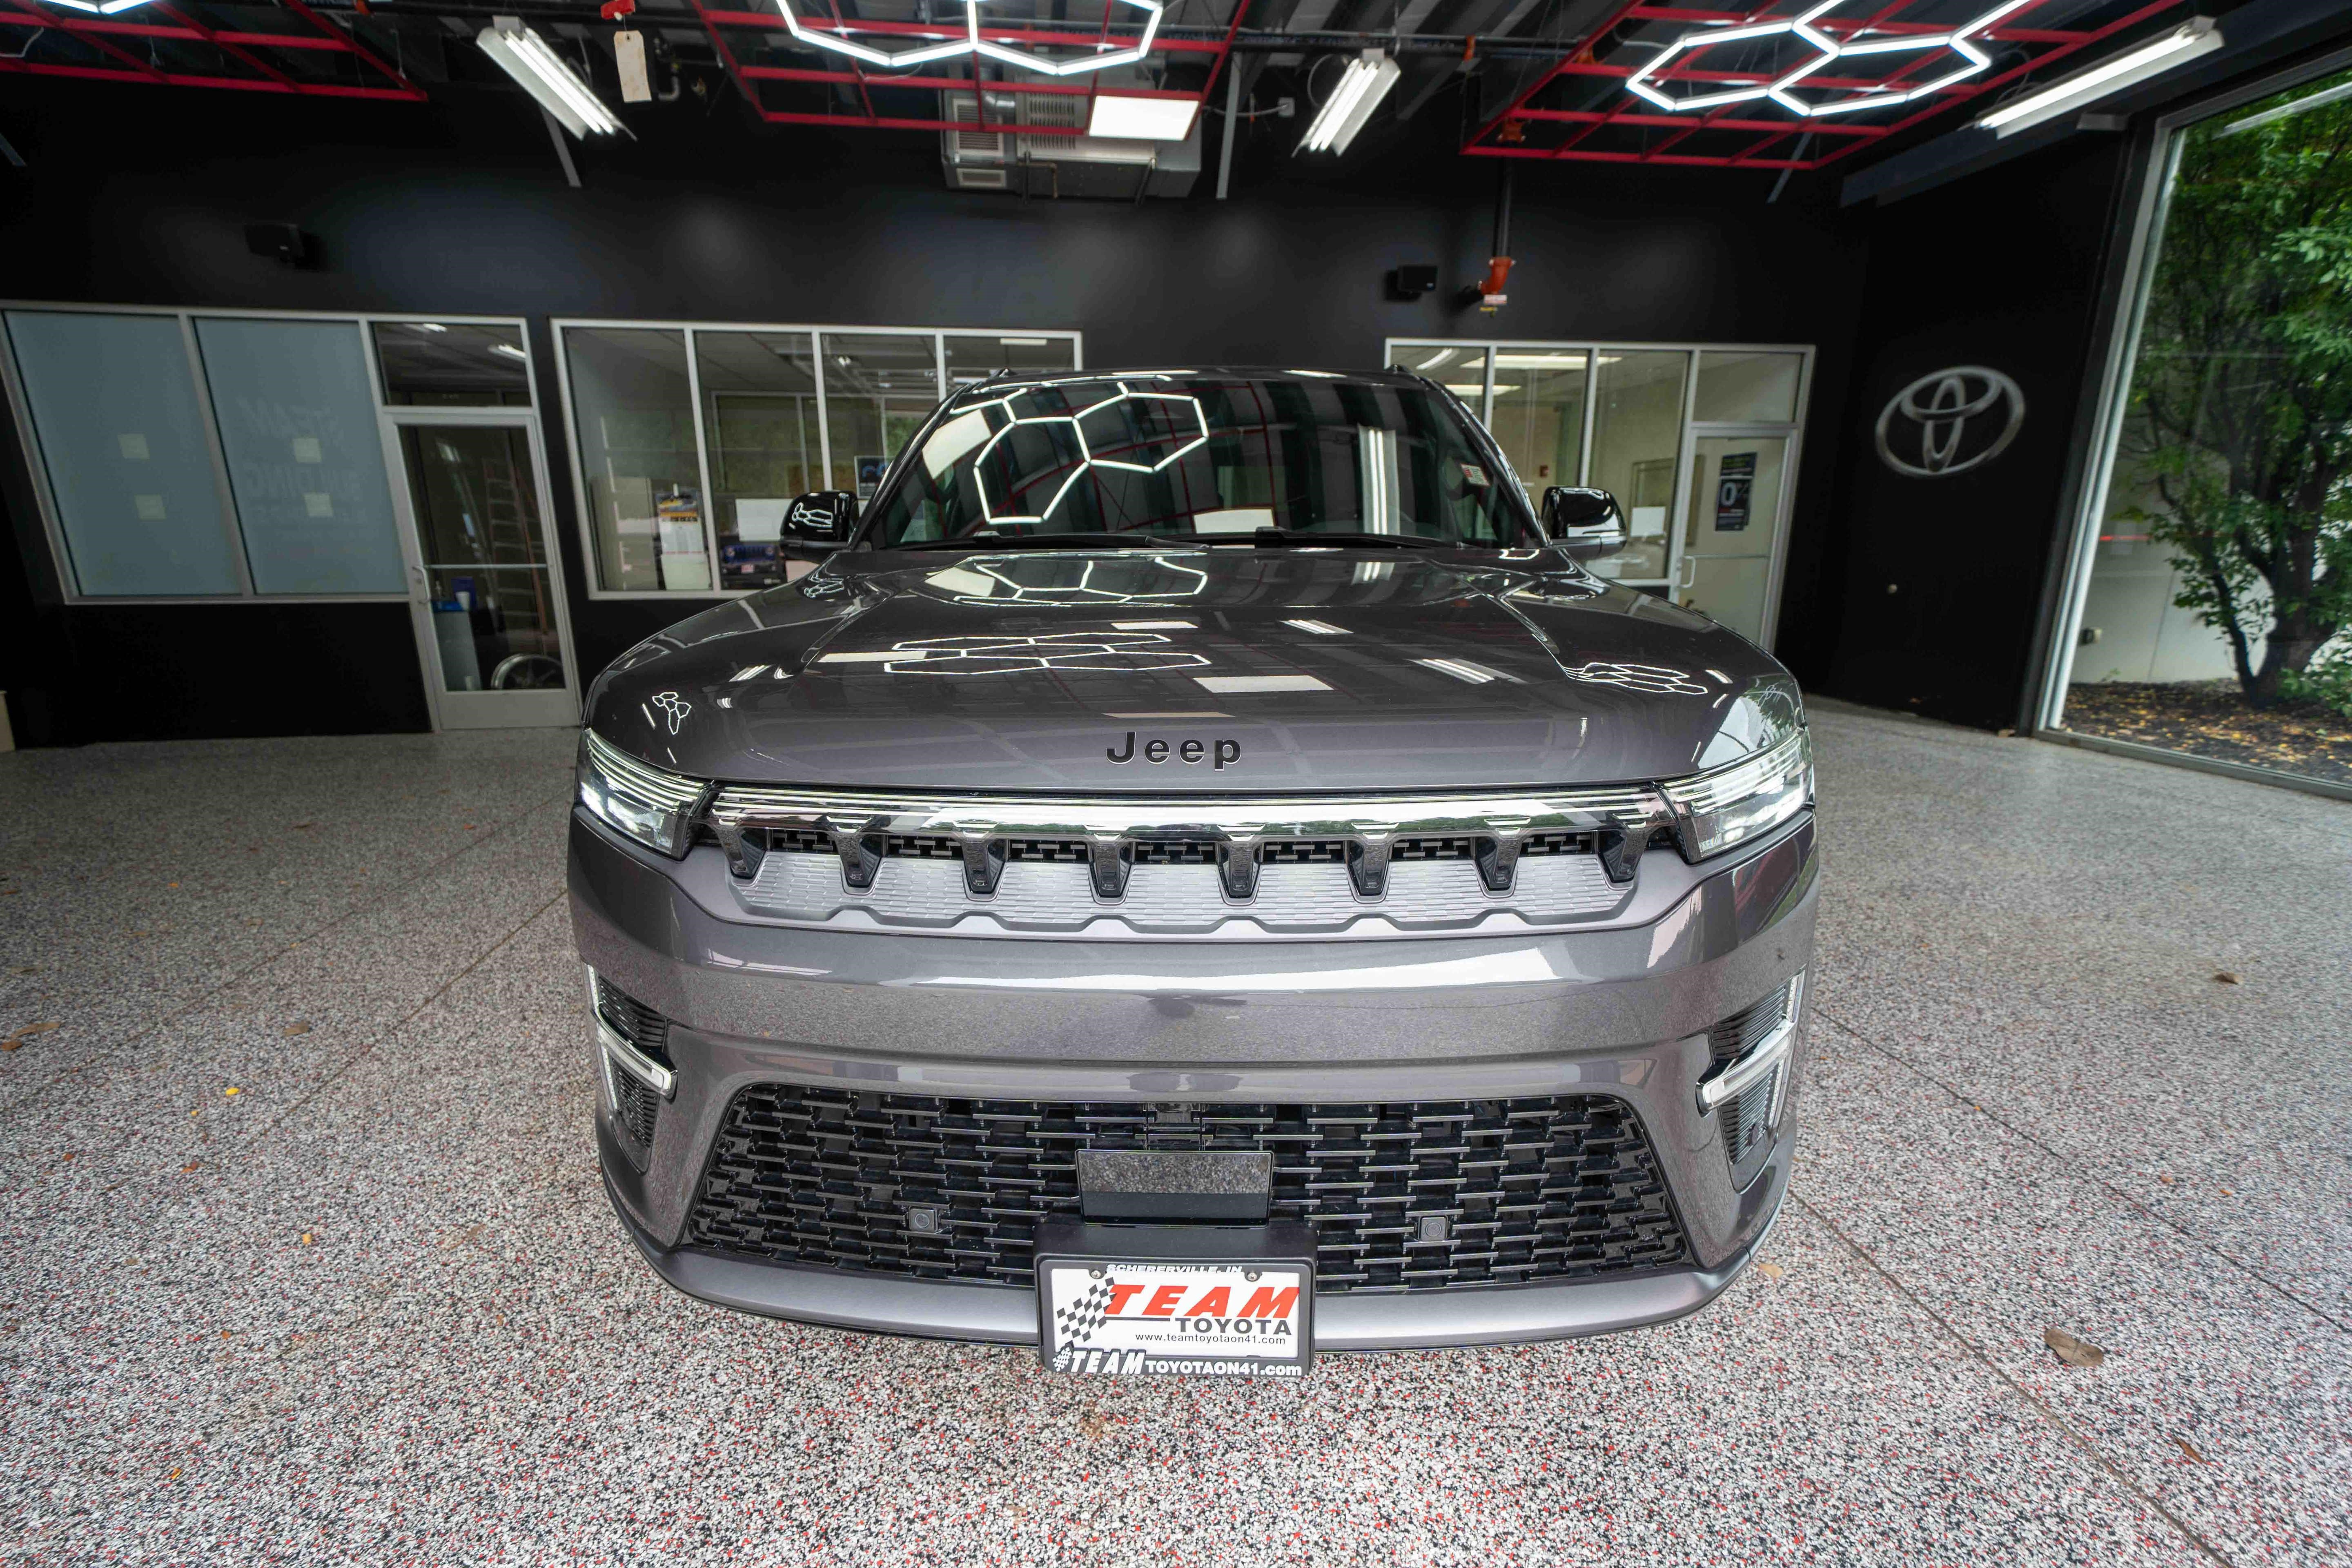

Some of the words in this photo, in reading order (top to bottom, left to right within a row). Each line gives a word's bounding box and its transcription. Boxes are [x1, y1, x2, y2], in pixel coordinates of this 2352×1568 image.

[1106, 731, 1242, 771] Jeep
[1105, 1284, 1299, 1319] TEAM
[1136, 1333, 1285, 1345] www.teamtoyotaon41.com
[1176, 1318, 1291, 1335] TOYOTA
[1071, 1350, 1146, 1374] TEAM
[1145, 1360, 1302, 1376] TOYOTAON41.com
